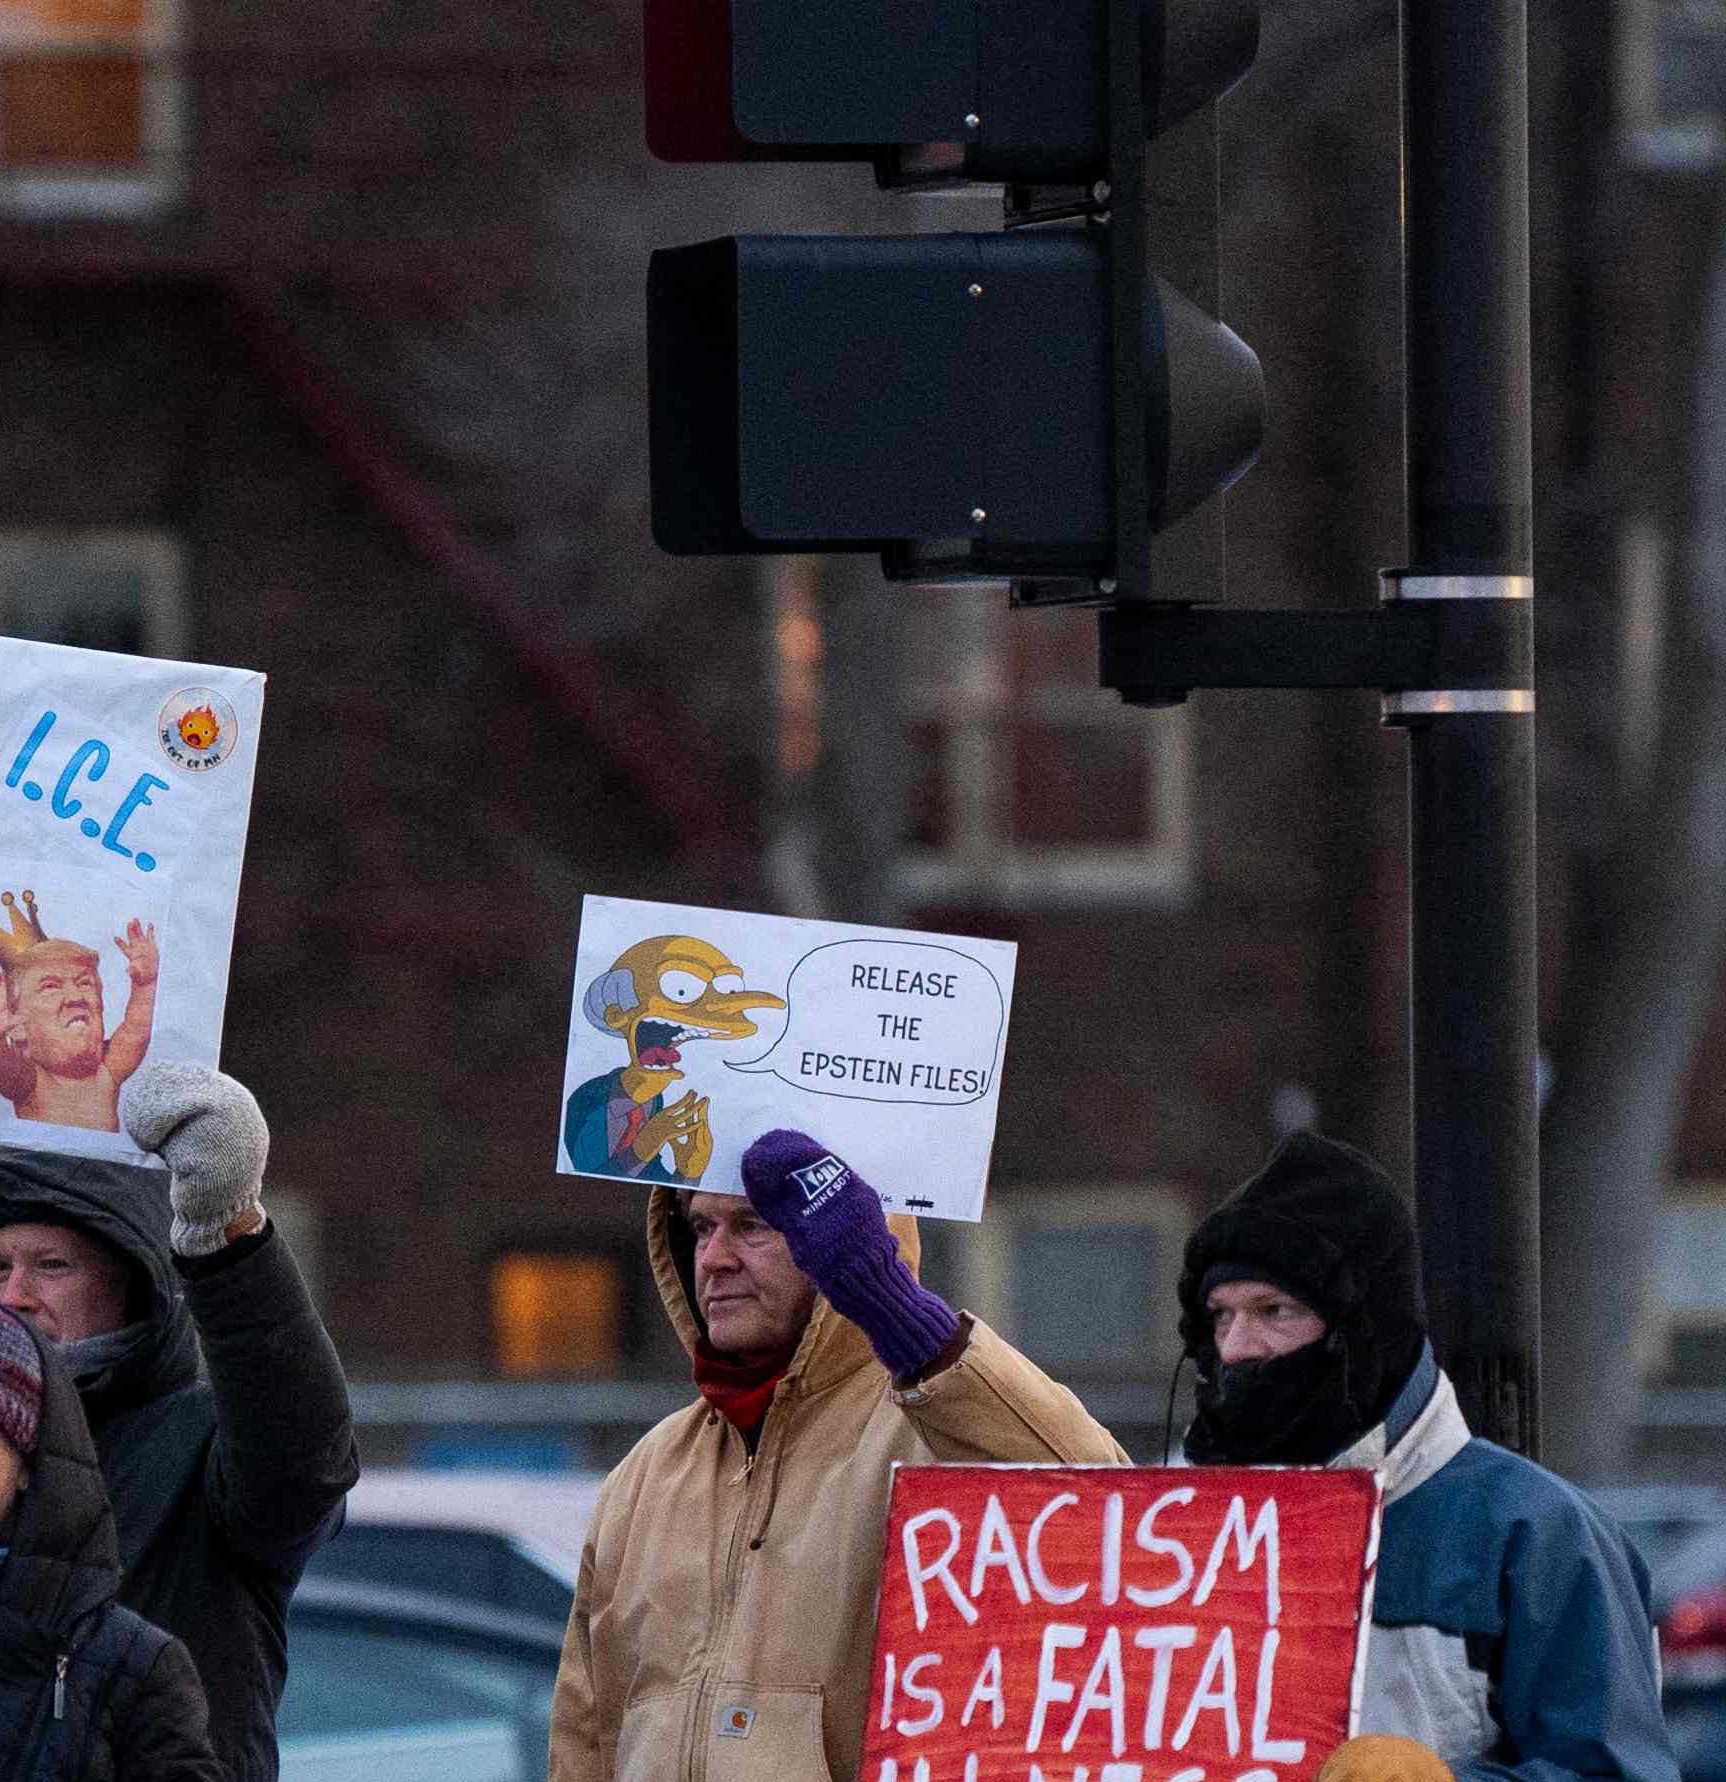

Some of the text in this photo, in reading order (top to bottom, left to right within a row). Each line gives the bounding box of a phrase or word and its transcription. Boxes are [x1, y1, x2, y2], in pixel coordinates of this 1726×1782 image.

[5, 710, 170, 872] I.C.E.
[851, 963, 959, 999] RELEASE
[877, 1012, 923, 1042] THE
[799, 1051, 988, 1096] EPSTEIN FILES!
[802, 1169, 853, 1217] MINNESOT
[902, 1486, 1282, 1632] RACISM
[878, 1622, 1307, 1763] IS A FATAL
